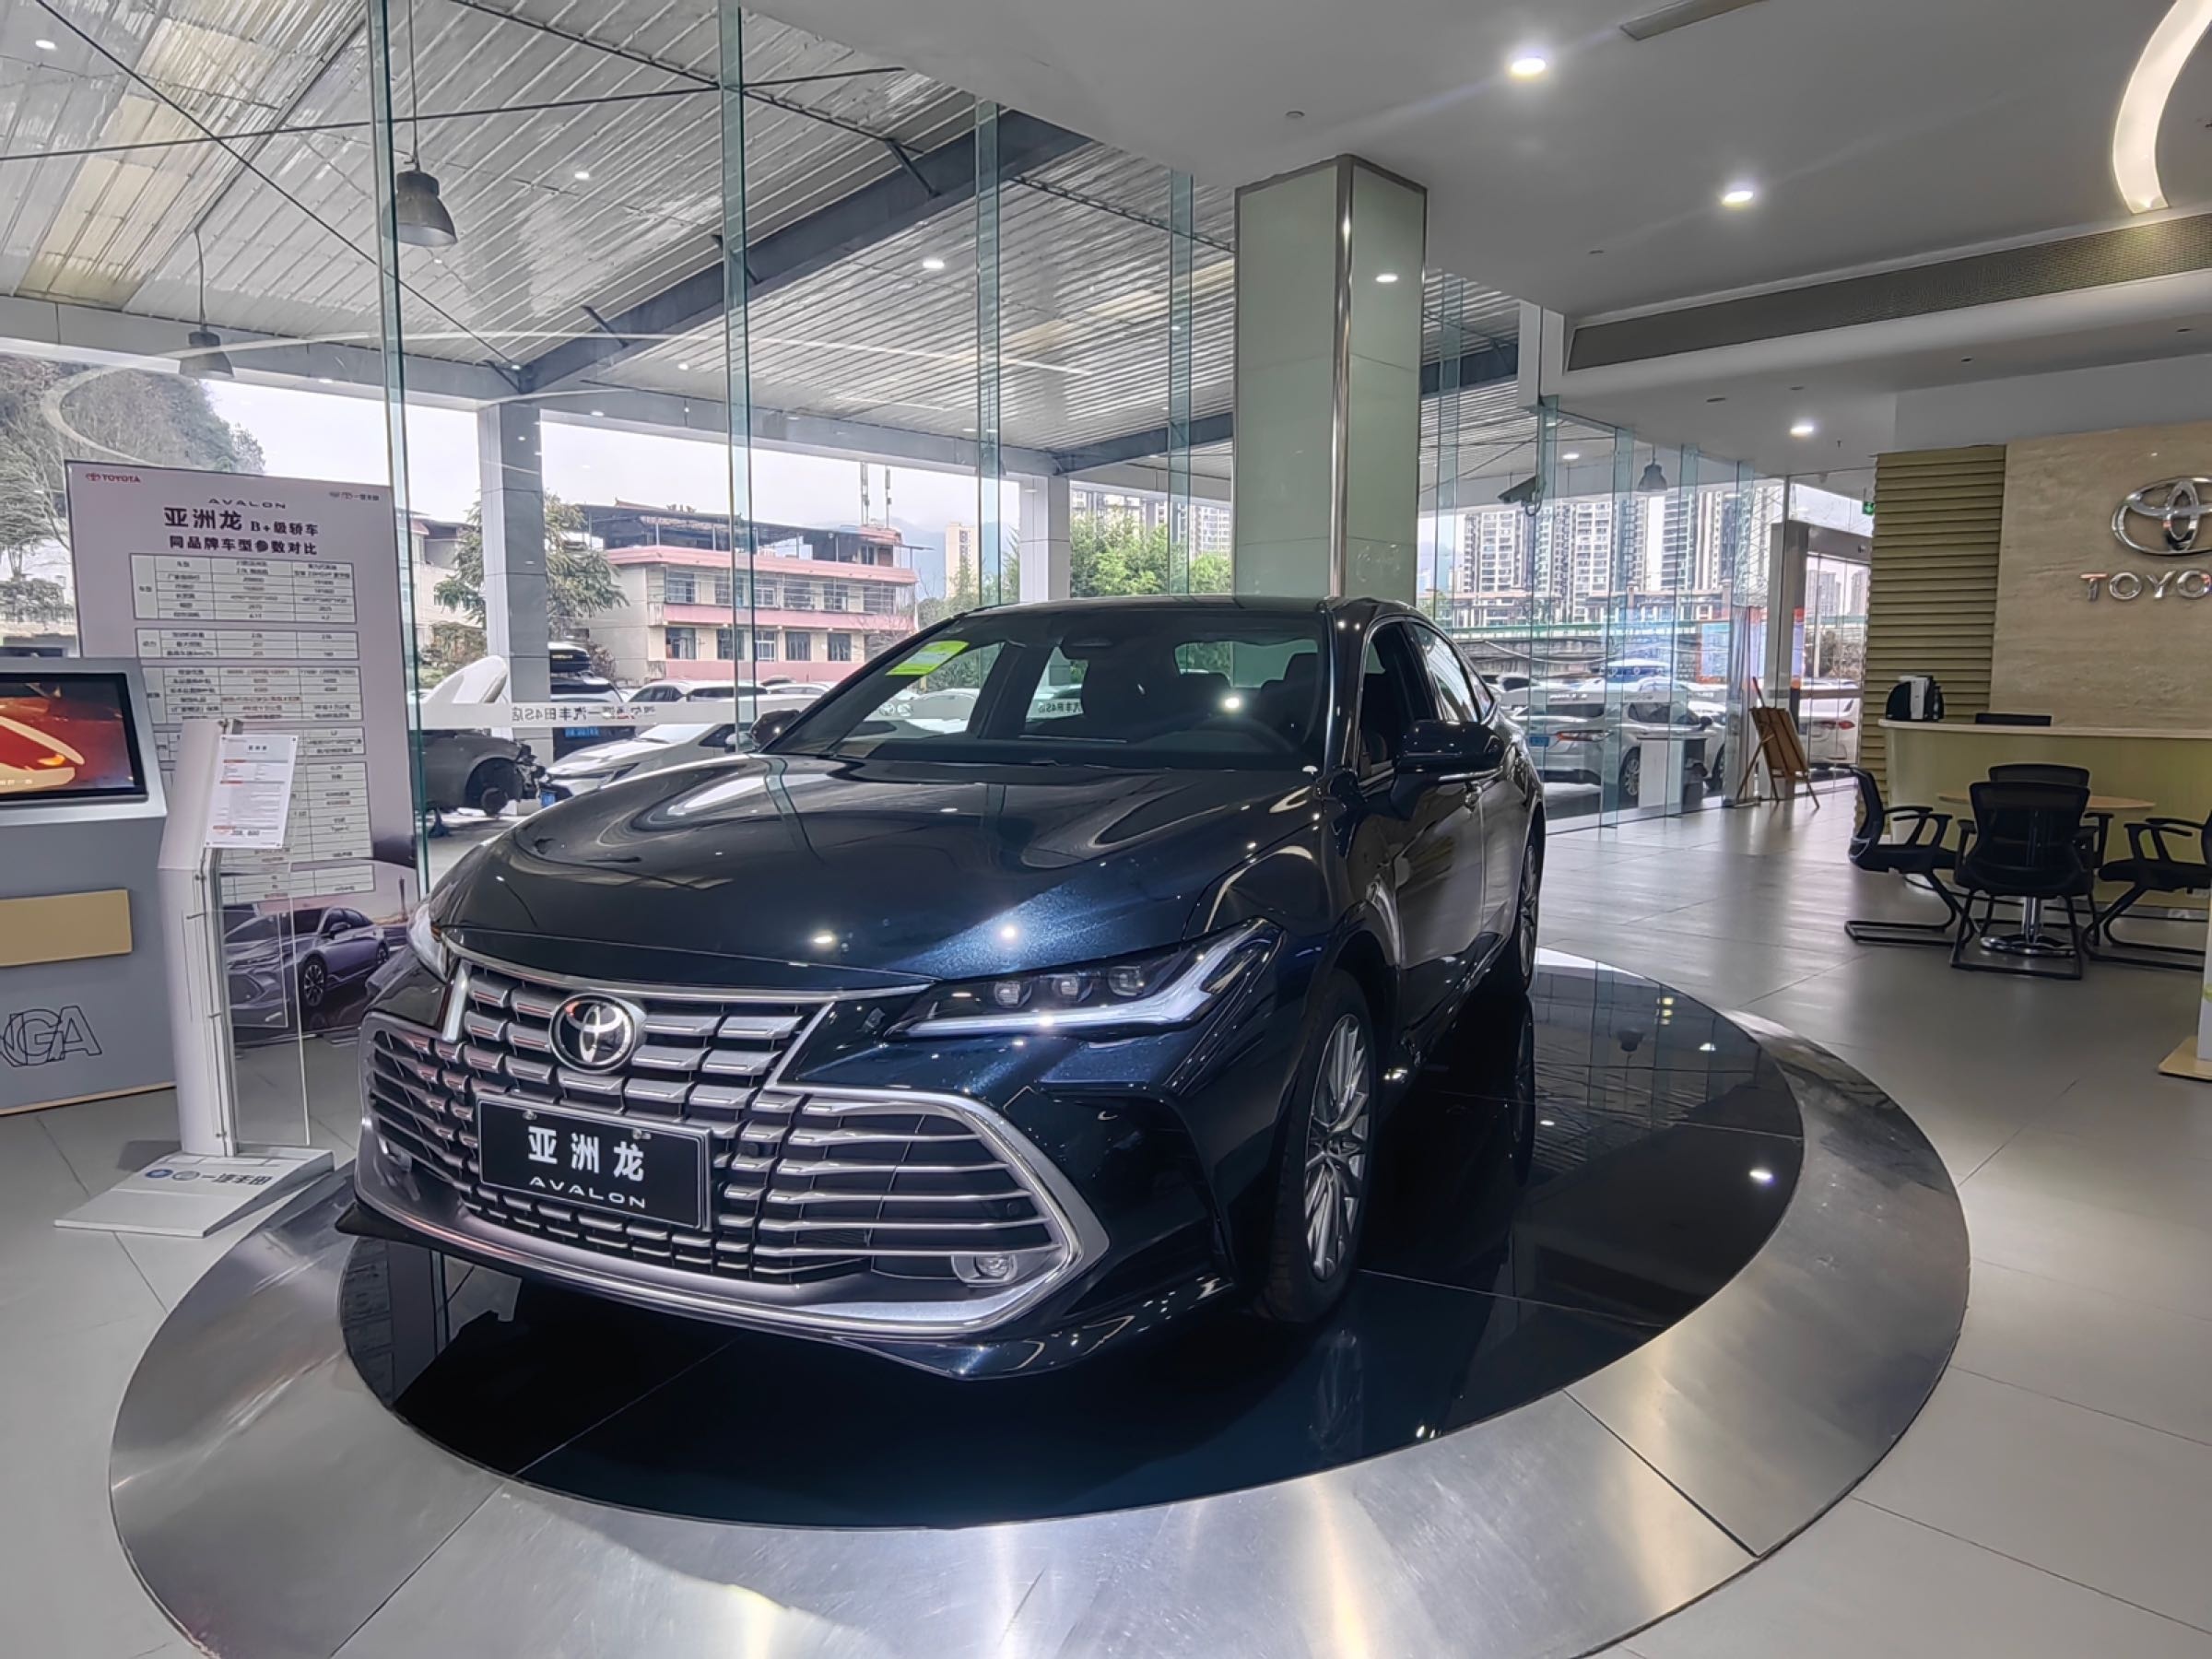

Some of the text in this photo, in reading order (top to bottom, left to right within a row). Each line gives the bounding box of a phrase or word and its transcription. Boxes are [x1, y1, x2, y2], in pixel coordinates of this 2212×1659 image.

[102, 474, 141, 483] TOYOTA
[208, 498, 287, 509] AVALON
[164, 507, 319, 536] 亚洲龙 B+级轿车
[170, 535, 317, 555] 同品牌车型参数对比
[528, 1125, 644, 1182] 亚洲龙
[529, 1176, 645, 1208] AVALON
